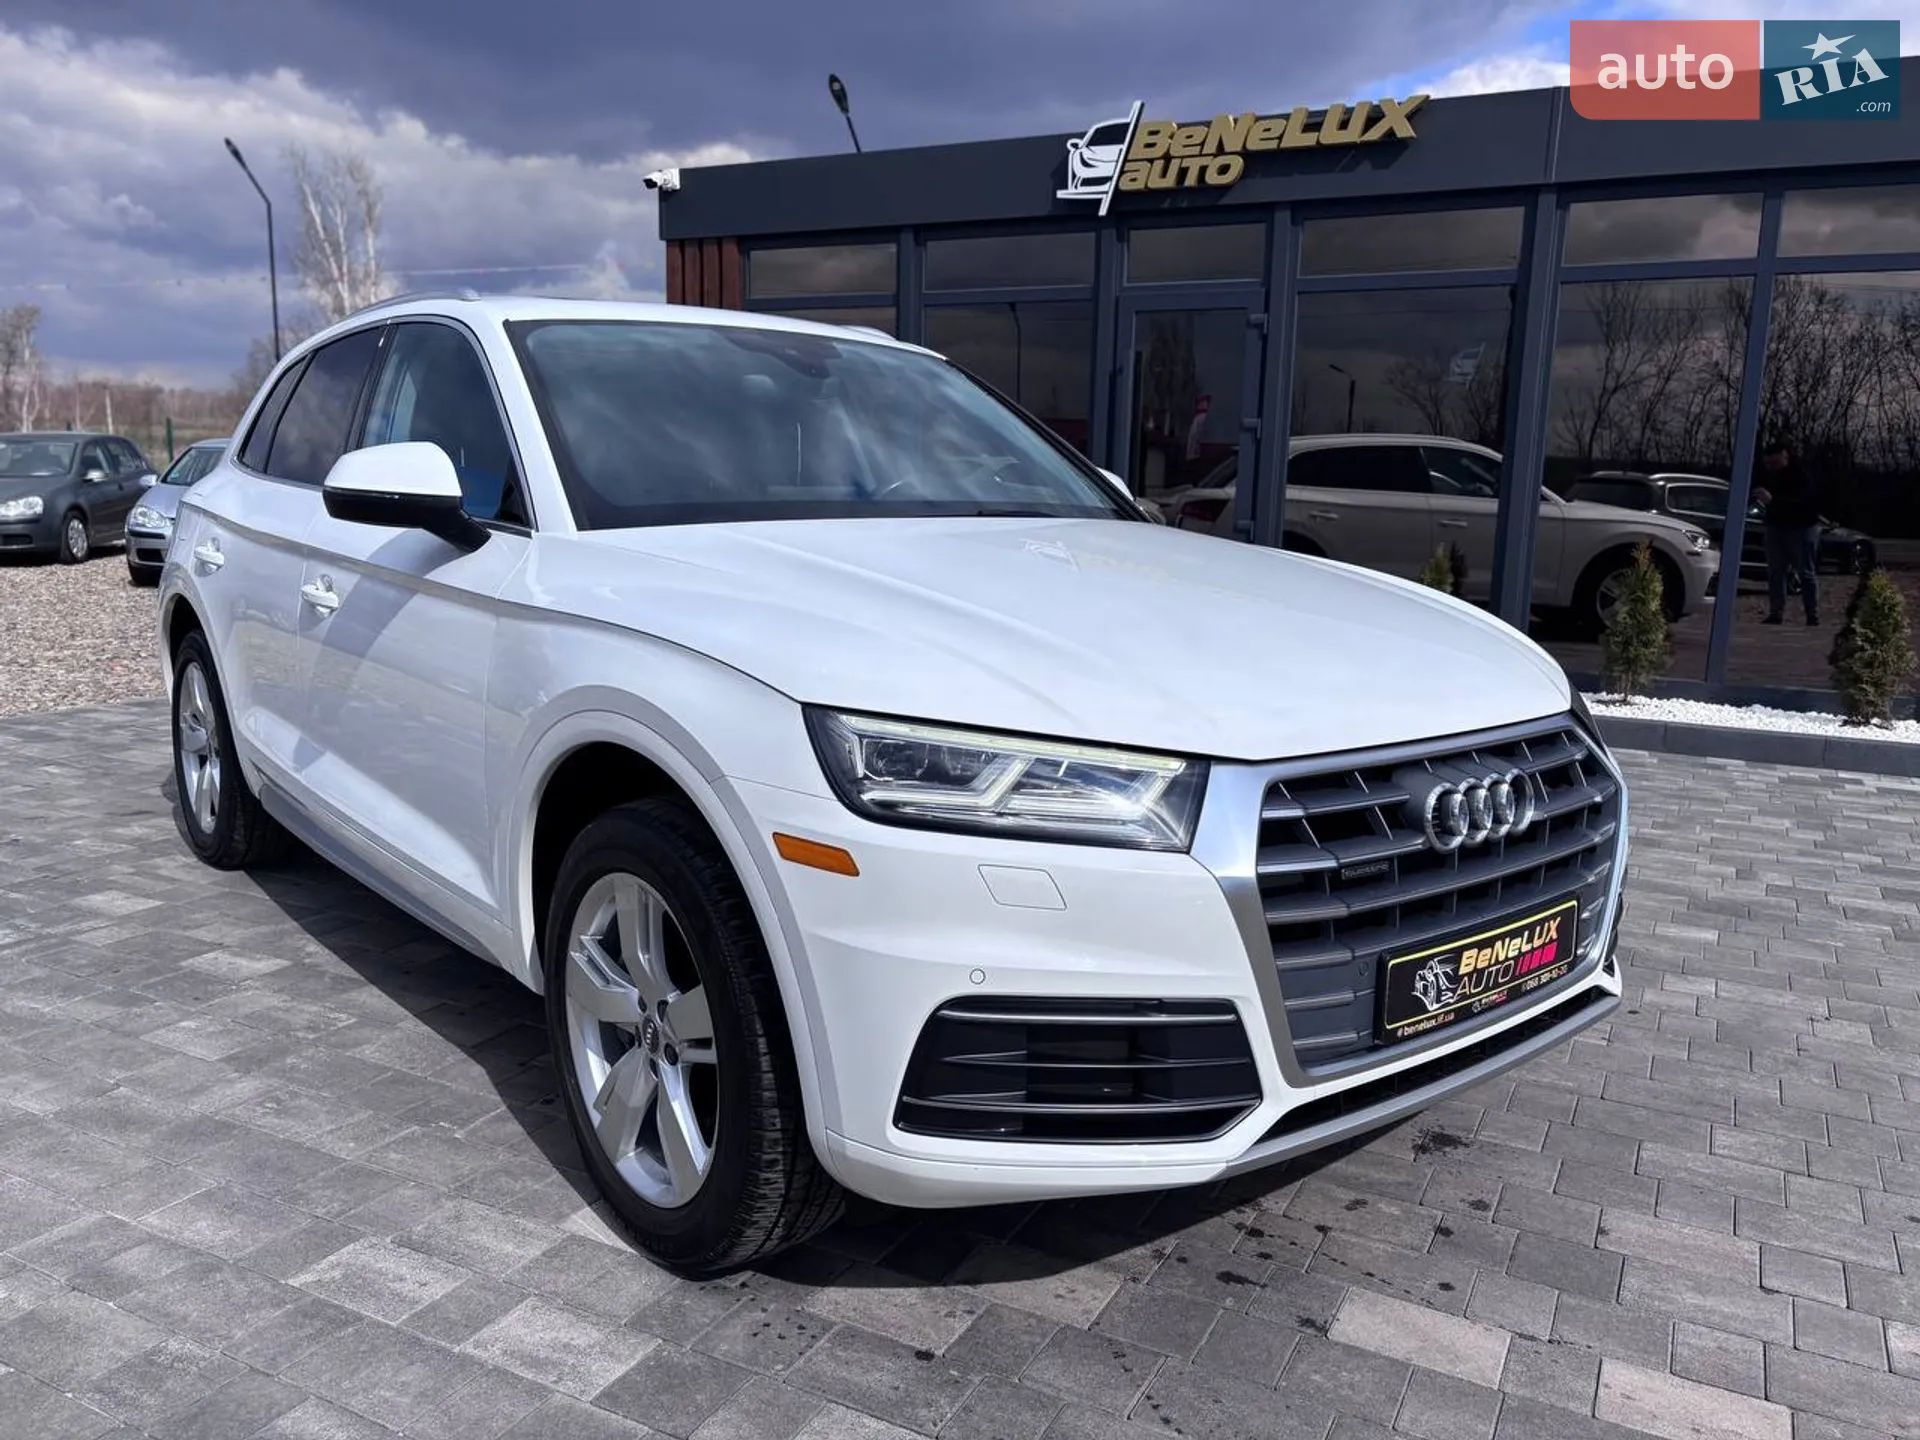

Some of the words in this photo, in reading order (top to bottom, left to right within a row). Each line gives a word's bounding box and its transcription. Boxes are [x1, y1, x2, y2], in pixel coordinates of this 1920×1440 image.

[1127, 95, 1430, 160] BeNeLUX
[1458, 916, 1561, 975] BeNeLUX
[1456, 963, 1515, 996] AUTO
